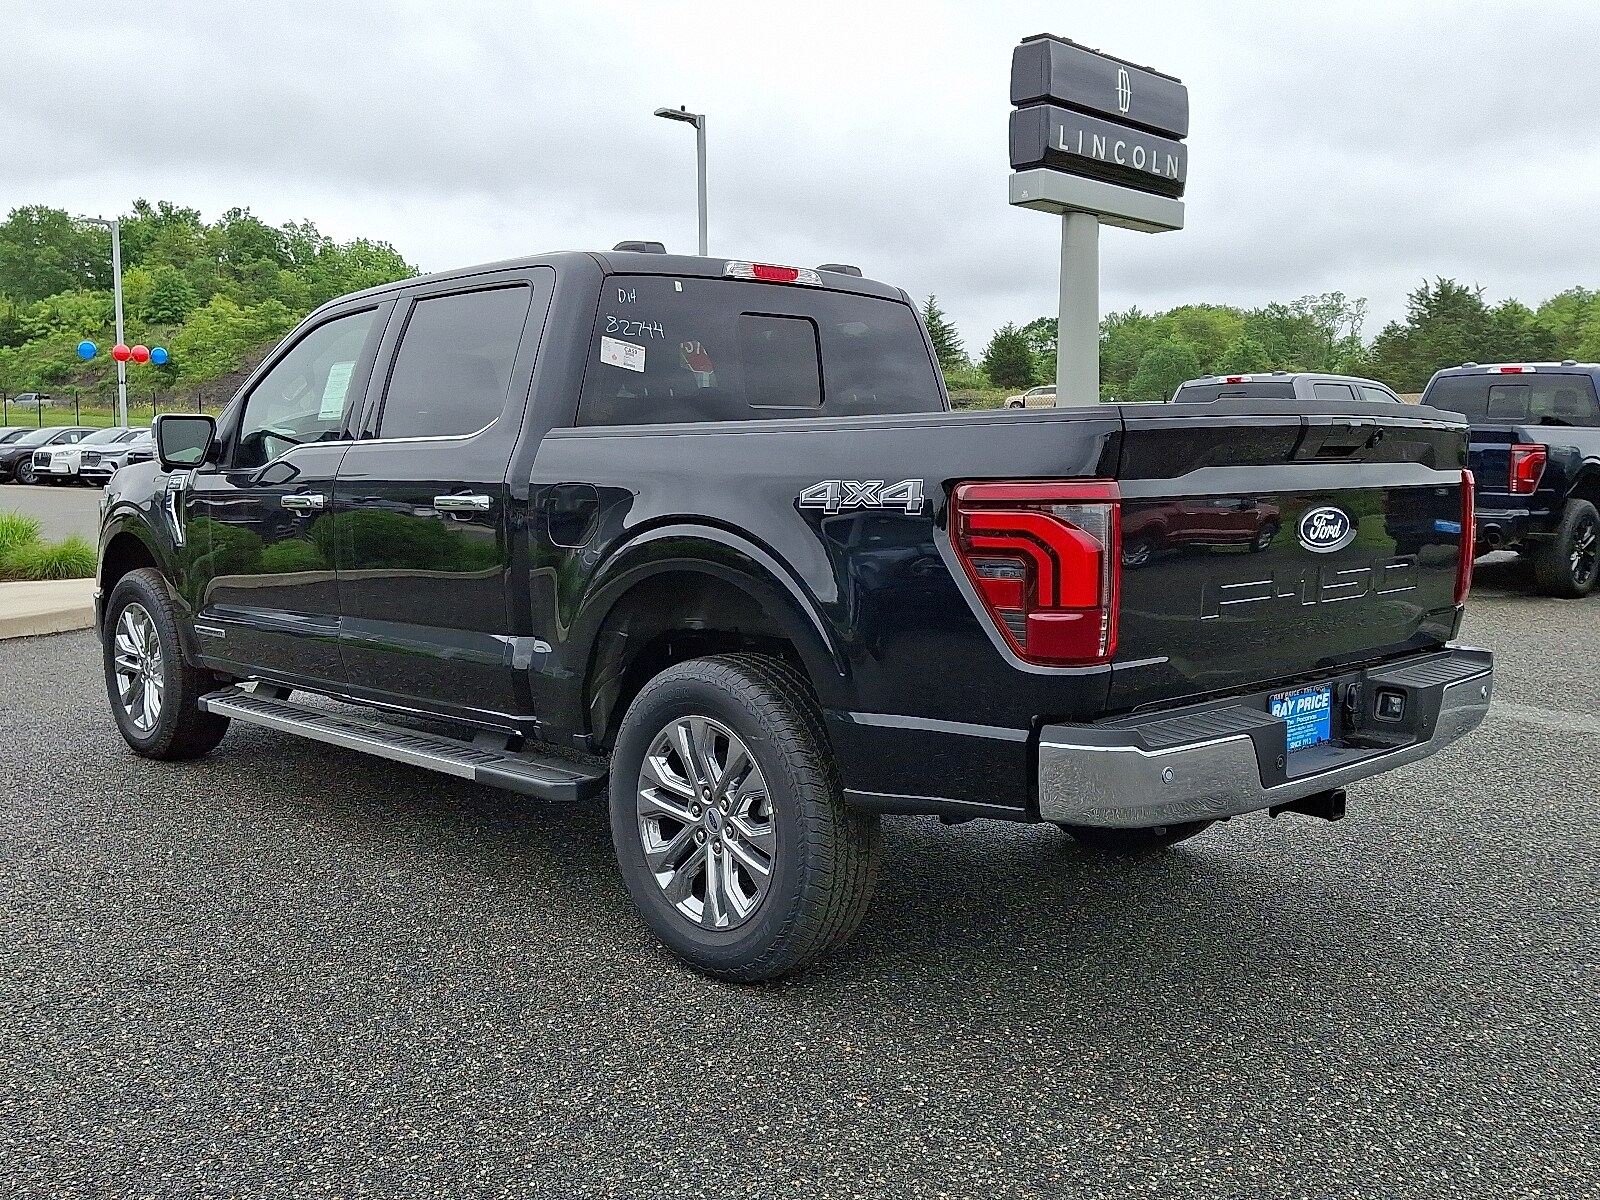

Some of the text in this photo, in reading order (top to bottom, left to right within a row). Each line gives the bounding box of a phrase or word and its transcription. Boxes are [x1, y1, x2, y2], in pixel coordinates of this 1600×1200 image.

[1058, 125, 1179, 178] LINCOLN
[606, 315, 665, 339] 82744
[1309, 513, 1342, 540] Ford
[1200, 554, 1418, 620] F-150
[1271, 692, 1330, 718] RAY PRICE
